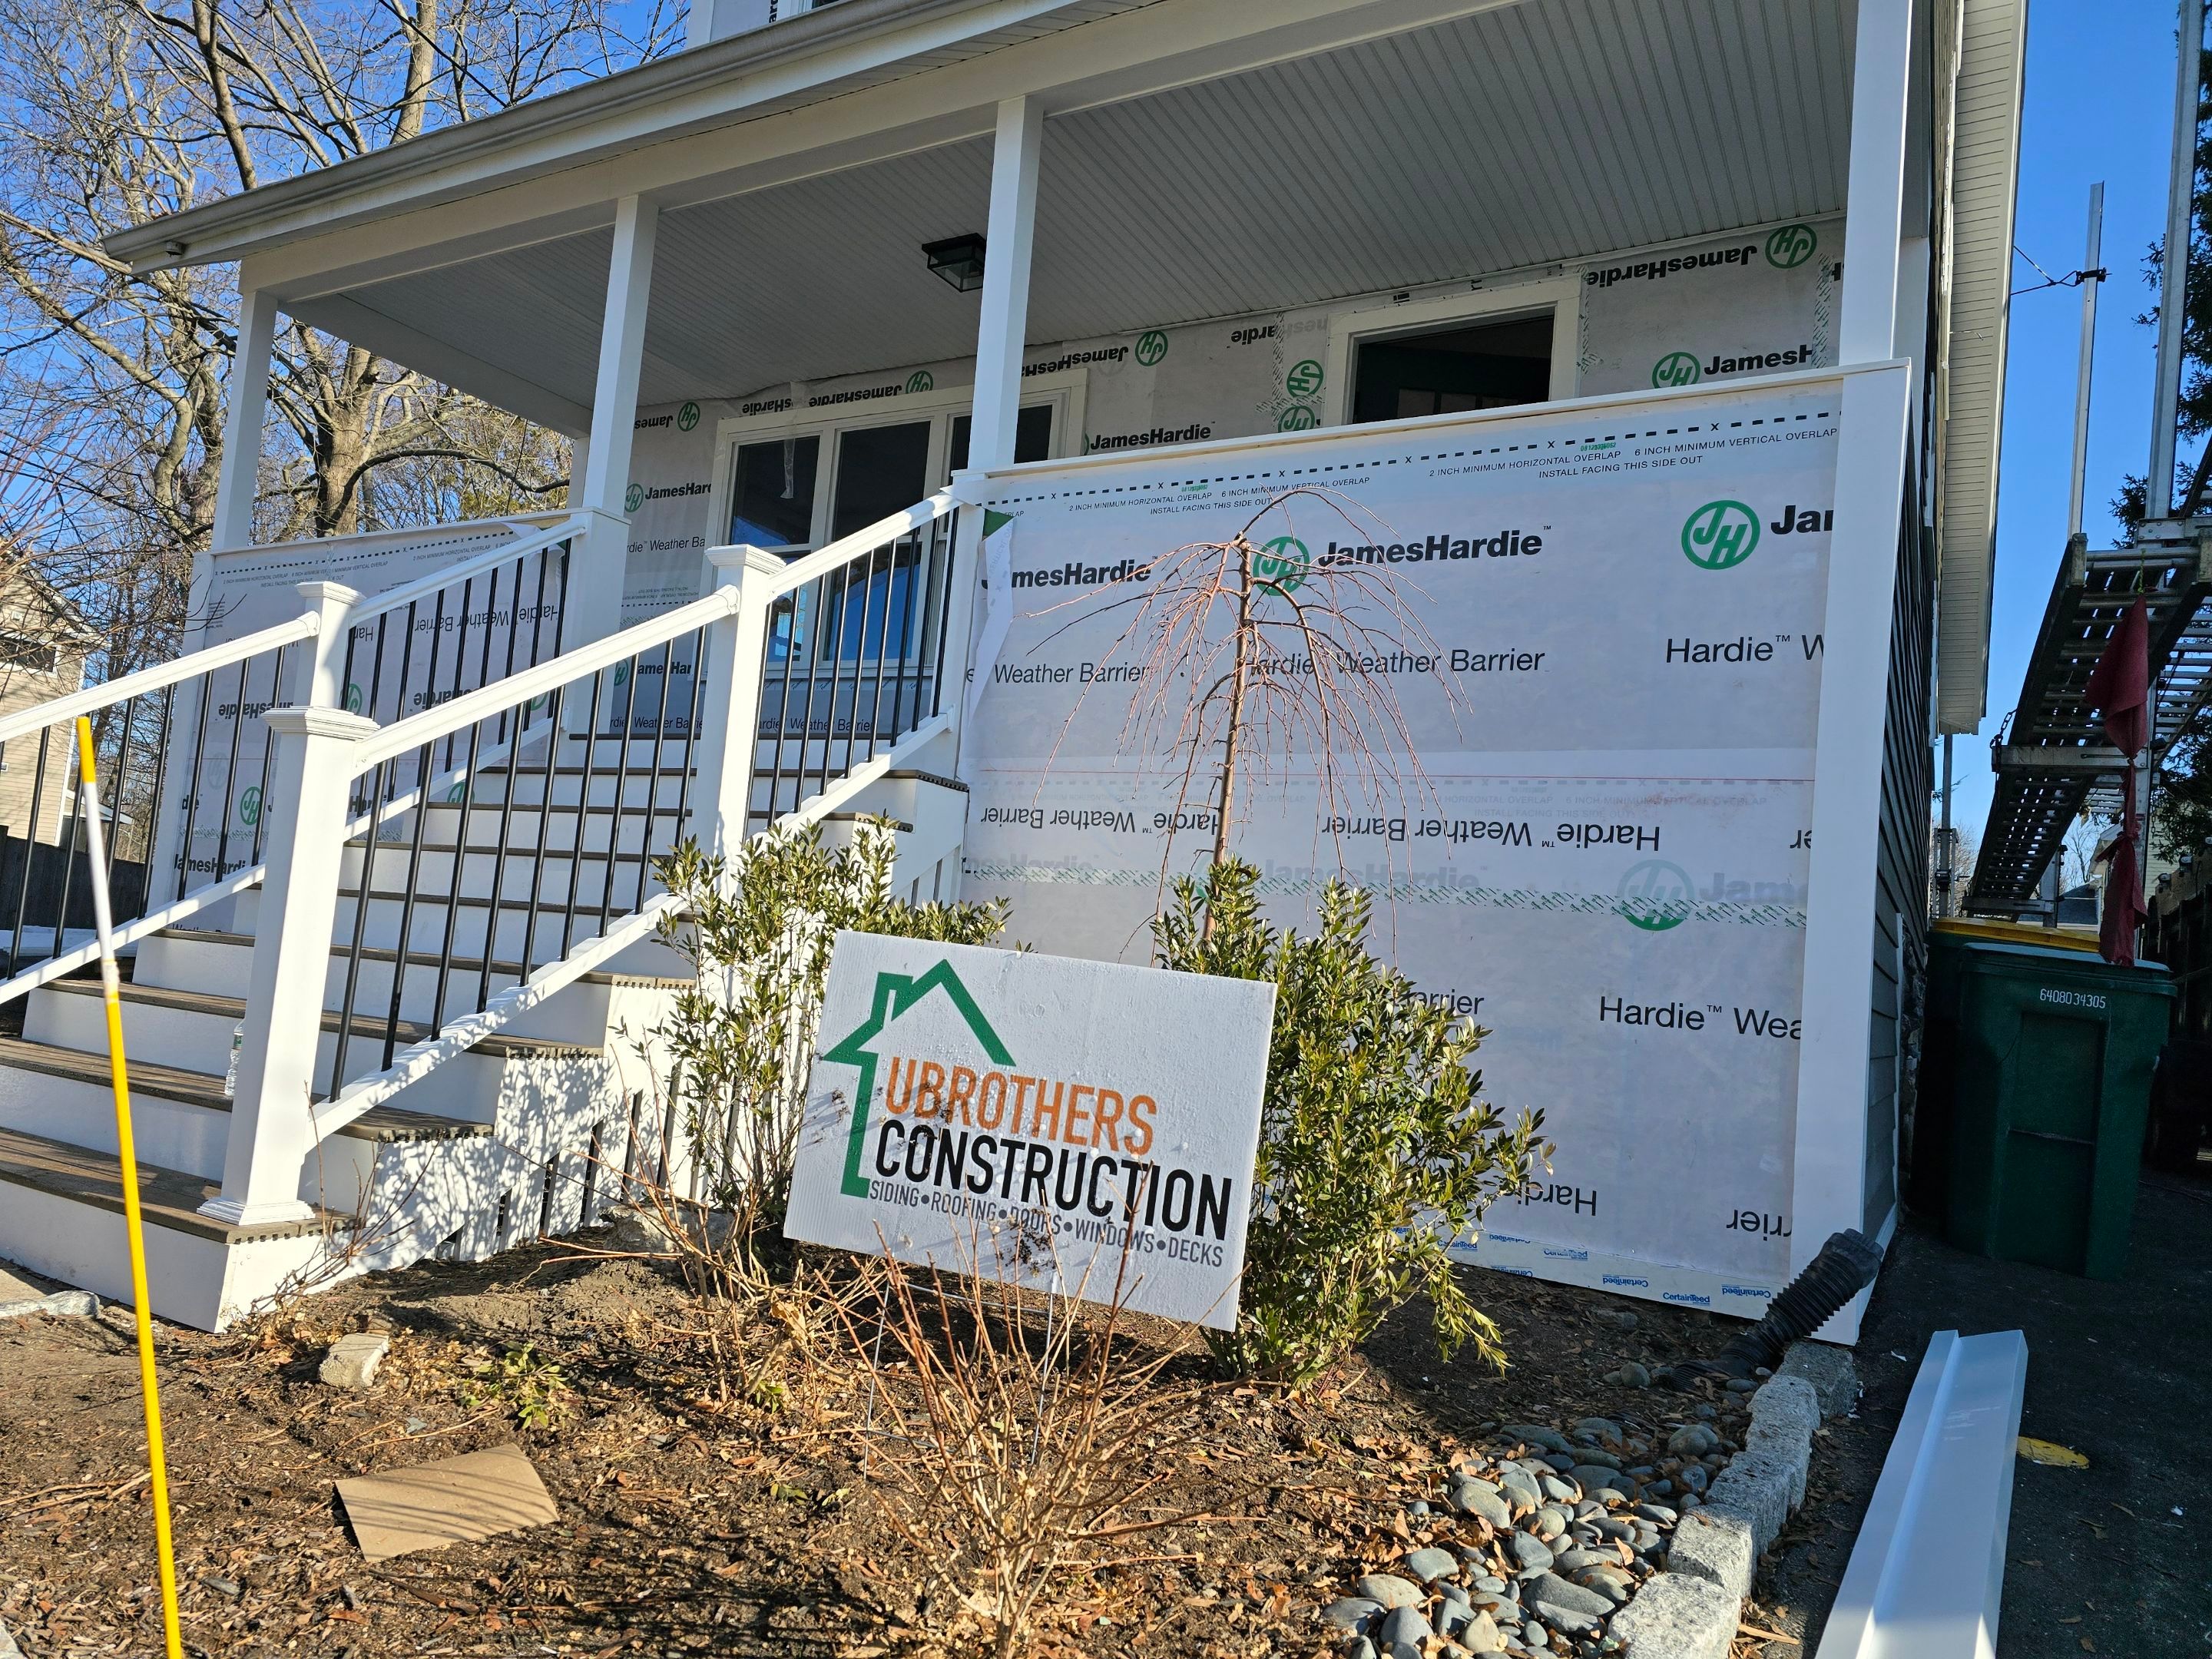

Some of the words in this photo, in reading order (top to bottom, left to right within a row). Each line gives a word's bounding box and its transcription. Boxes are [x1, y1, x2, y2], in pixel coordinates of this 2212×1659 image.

[1588, 245, 1757, 288] JamesHardie
[1437, 468, 1460, 476] INCH
[1462, 462, 1506, 473] MINIMUM
[1508, 457, 1571, 469] HORIZONTAL
[1574, 450, 1621, 462] OVERLAP
[1644, 445, 1671, 455] INCH
[1674, 440, 1725, 452] MINIMUM
[1730, 434, 1782, 447] VERTICAL
[1786, 428, 1837, 441] OVERLAP
[1539, 469, 1578, 478] INSTALL
[1581, 465, 1620, 475] FACING
[1624, 461, 1648, 470] THIS
[1651, 459, 1676, 468] SIDE
[1680, 455, 1704, 465] OUT
[1094, 500, 1127, 509] MINIMUM
[1128, 496, 1175, 506] HORIZONTAL
[1177, 492, 1212, 502] OVERLAP
[1229, 488, 1248, 497] INCH
[1251, 484, 1289, 495] MINIMUM
[1292, 480, 1330, 490] VERTICAL
[1333, 477, 1370, 487] OVERLAP
[1150, 505, 1180, 515] INSTALL
[1182, 503, 1211, 512] FACING
[1233, 499, 1252, 508] SIDE
[1254, 497, 1273, 506] OUT
[650, 538, 690, 551] Weather
[994, 663, 1075, 683] Weather
[1079, 661, 1152, 684] Barrier
[1335, 650, 1442, 674] Weather
[1450, 647, 1545, 673] Barrier
[980, 807, 1044, 830] Barrier
[1049, 809, 1136, 833] Weather
[1321, 816, 1406, 842] Barrier
[1415, 820, 1532, 847] Weather
[884, 1056, 1157, 1157] UBROTHERS
[875, 1118, 1233, 1242] CONSTRUCTION
[1602, 1276, 1649, 1288] CertainTeed
[1722, 1286, 1772, 1299] CertainTeed
[1663, 1292, 1711, 1303] CertainTeed
